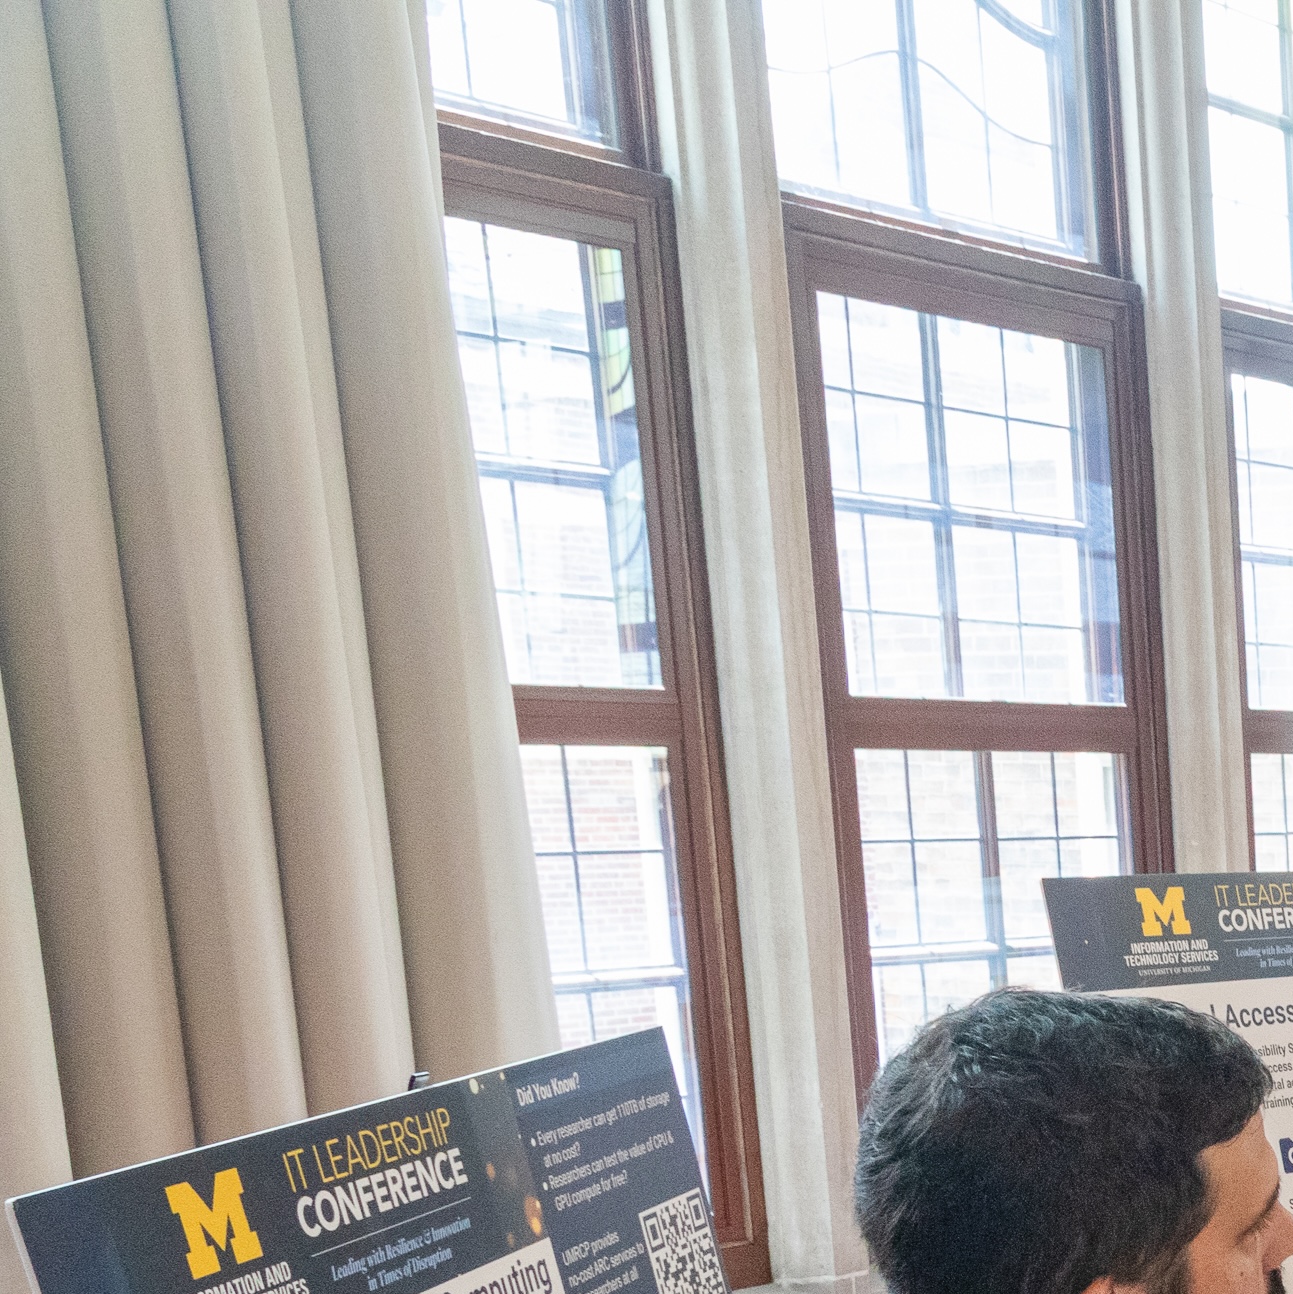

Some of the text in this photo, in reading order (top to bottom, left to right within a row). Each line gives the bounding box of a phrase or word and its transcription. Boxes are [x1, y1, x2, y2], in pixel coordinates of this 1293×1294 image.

[1134, 885, 1192, 937] M
[1213, 884, 1230, 907] IT
[1122, 949, 1219, 967] TECHNOLOGY SERVICES
[1129, 938, 1209, 955] INFORMATION AND
[515, 1071, 581, 1107] Did You Know?
[281, 1106, 451, 1193] IT LEADERSHIP
[296, 1146, 469, 1238] CONFERENCE
[164, 1167, 264, 1280] M
[264, 1260, 292, 1288] AND
